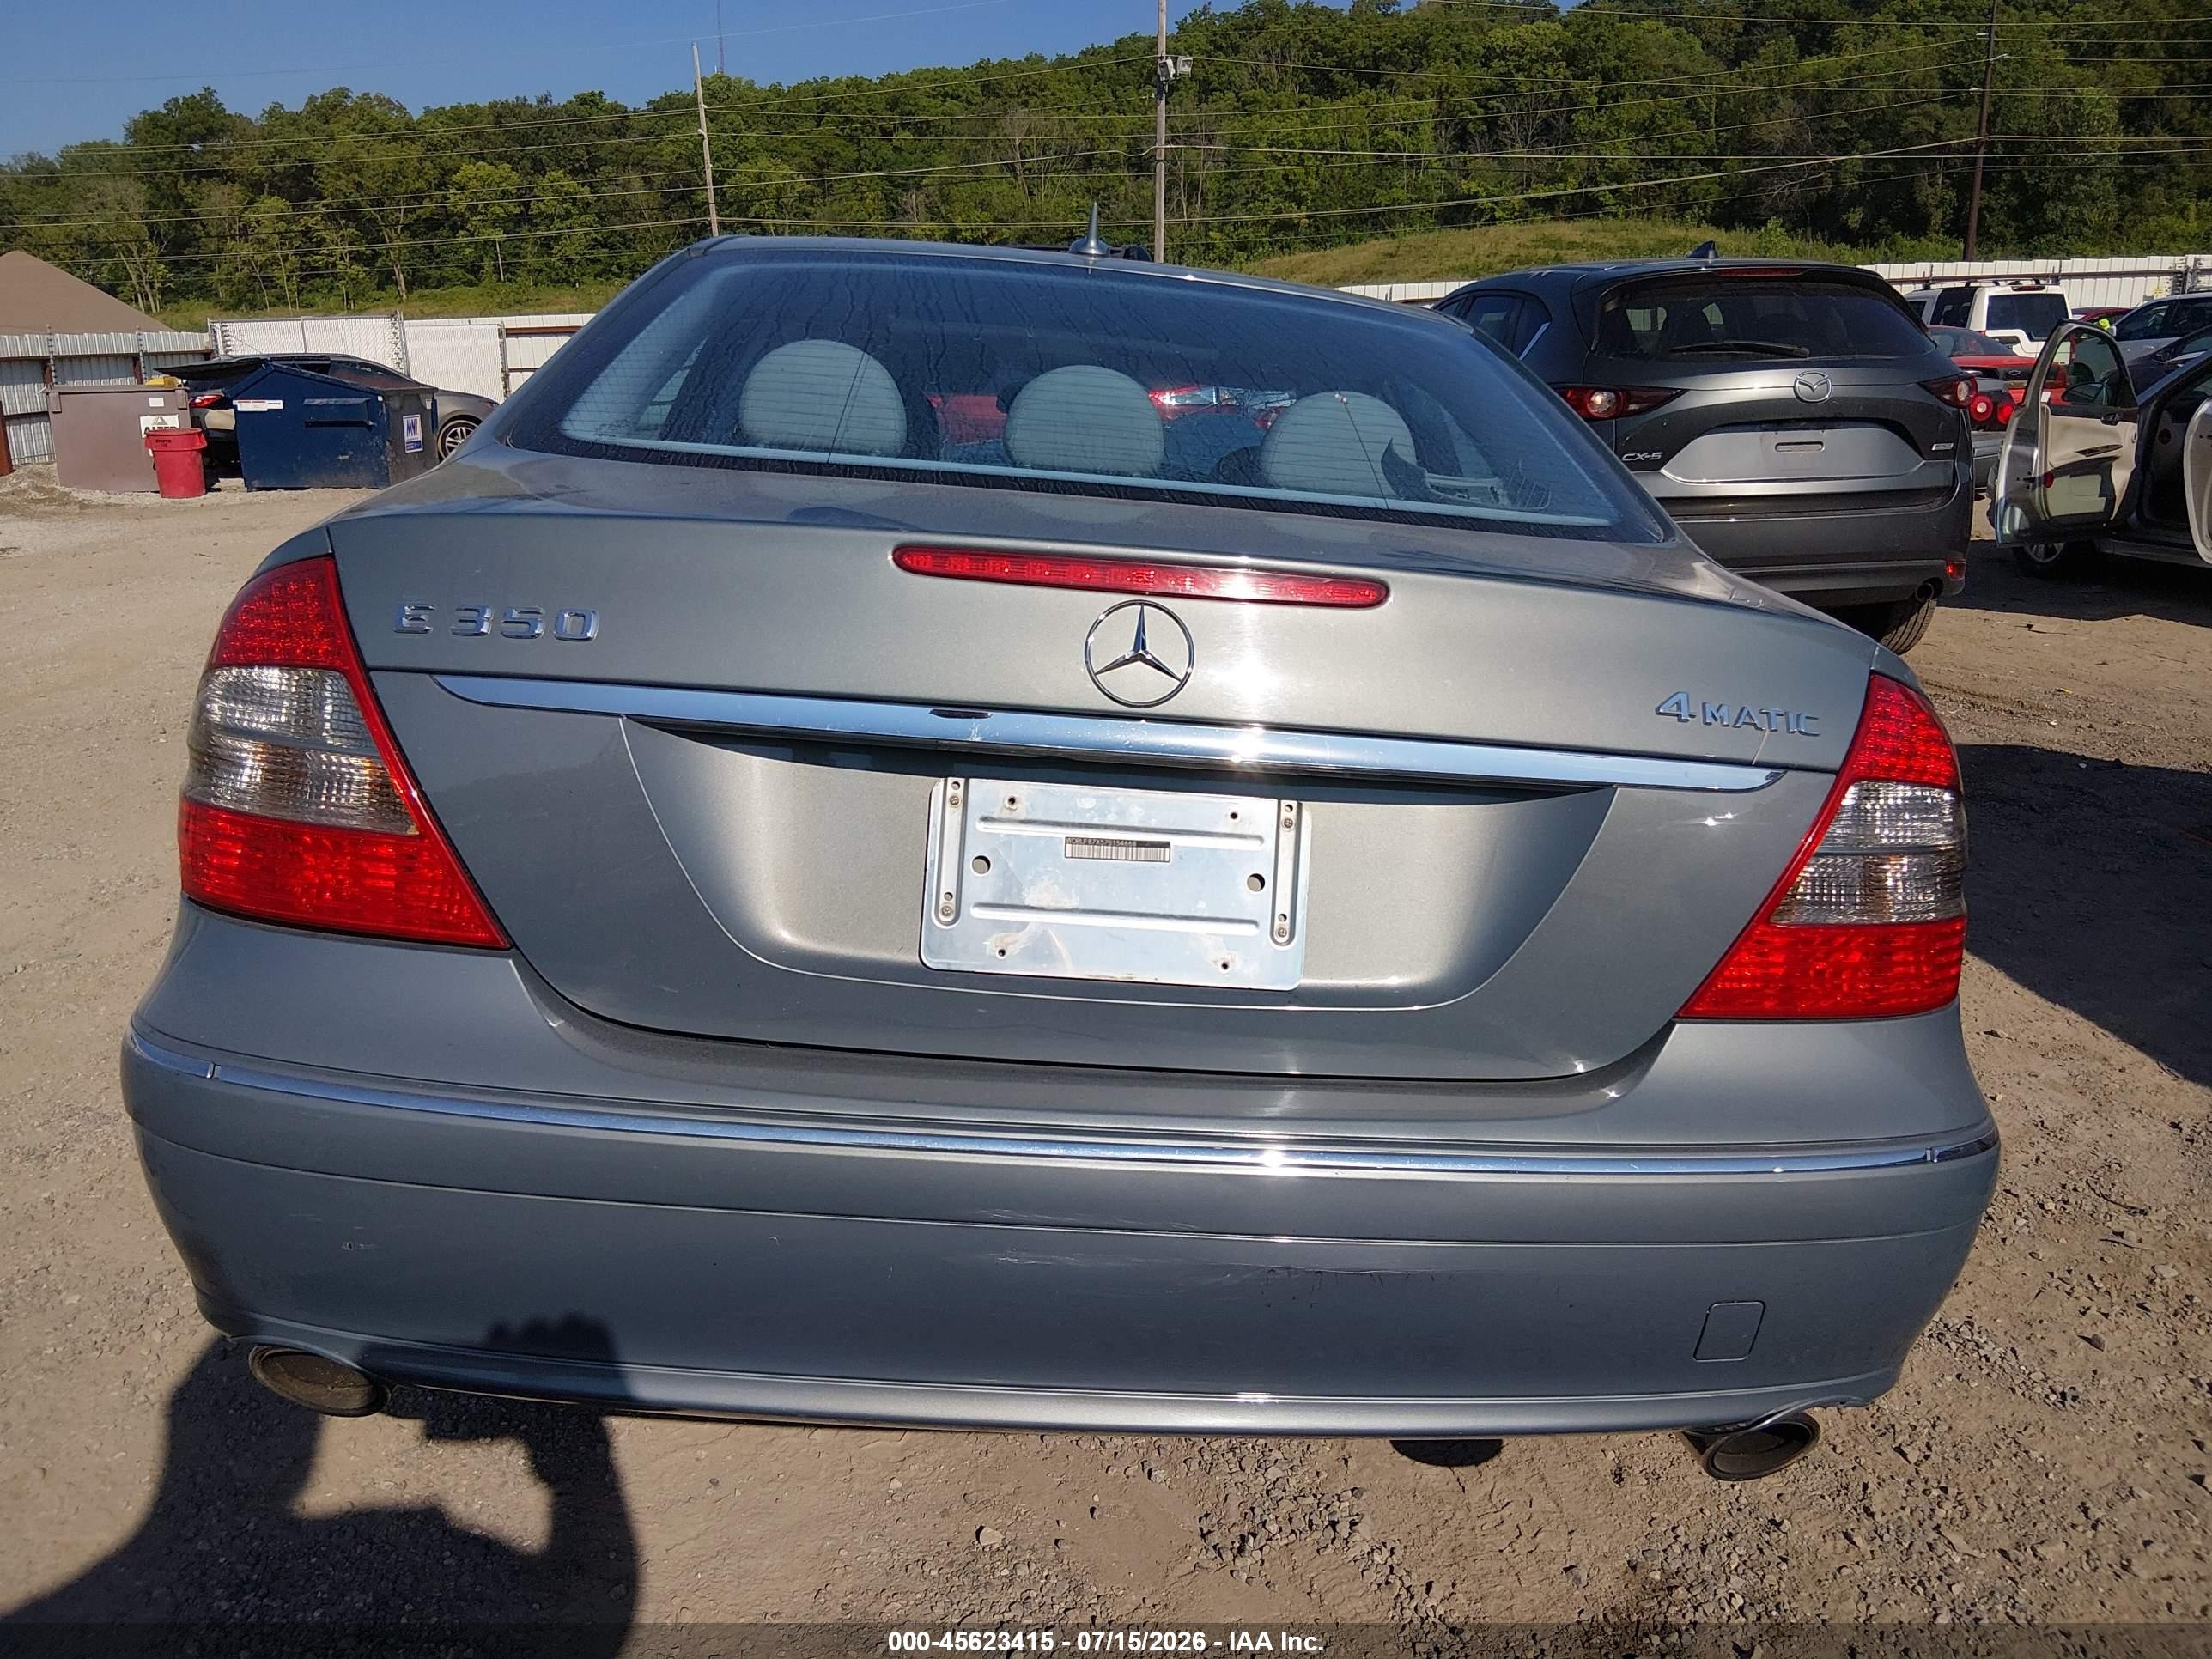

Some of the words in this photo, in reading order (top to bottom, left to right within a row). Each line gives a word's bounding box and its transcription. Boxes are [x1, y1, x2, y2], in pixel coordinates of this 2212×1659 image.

[1621, 452, 1663, 461] CX-5
[393, 602, 435, 635] E
[451, 604, 599, 642] 350
